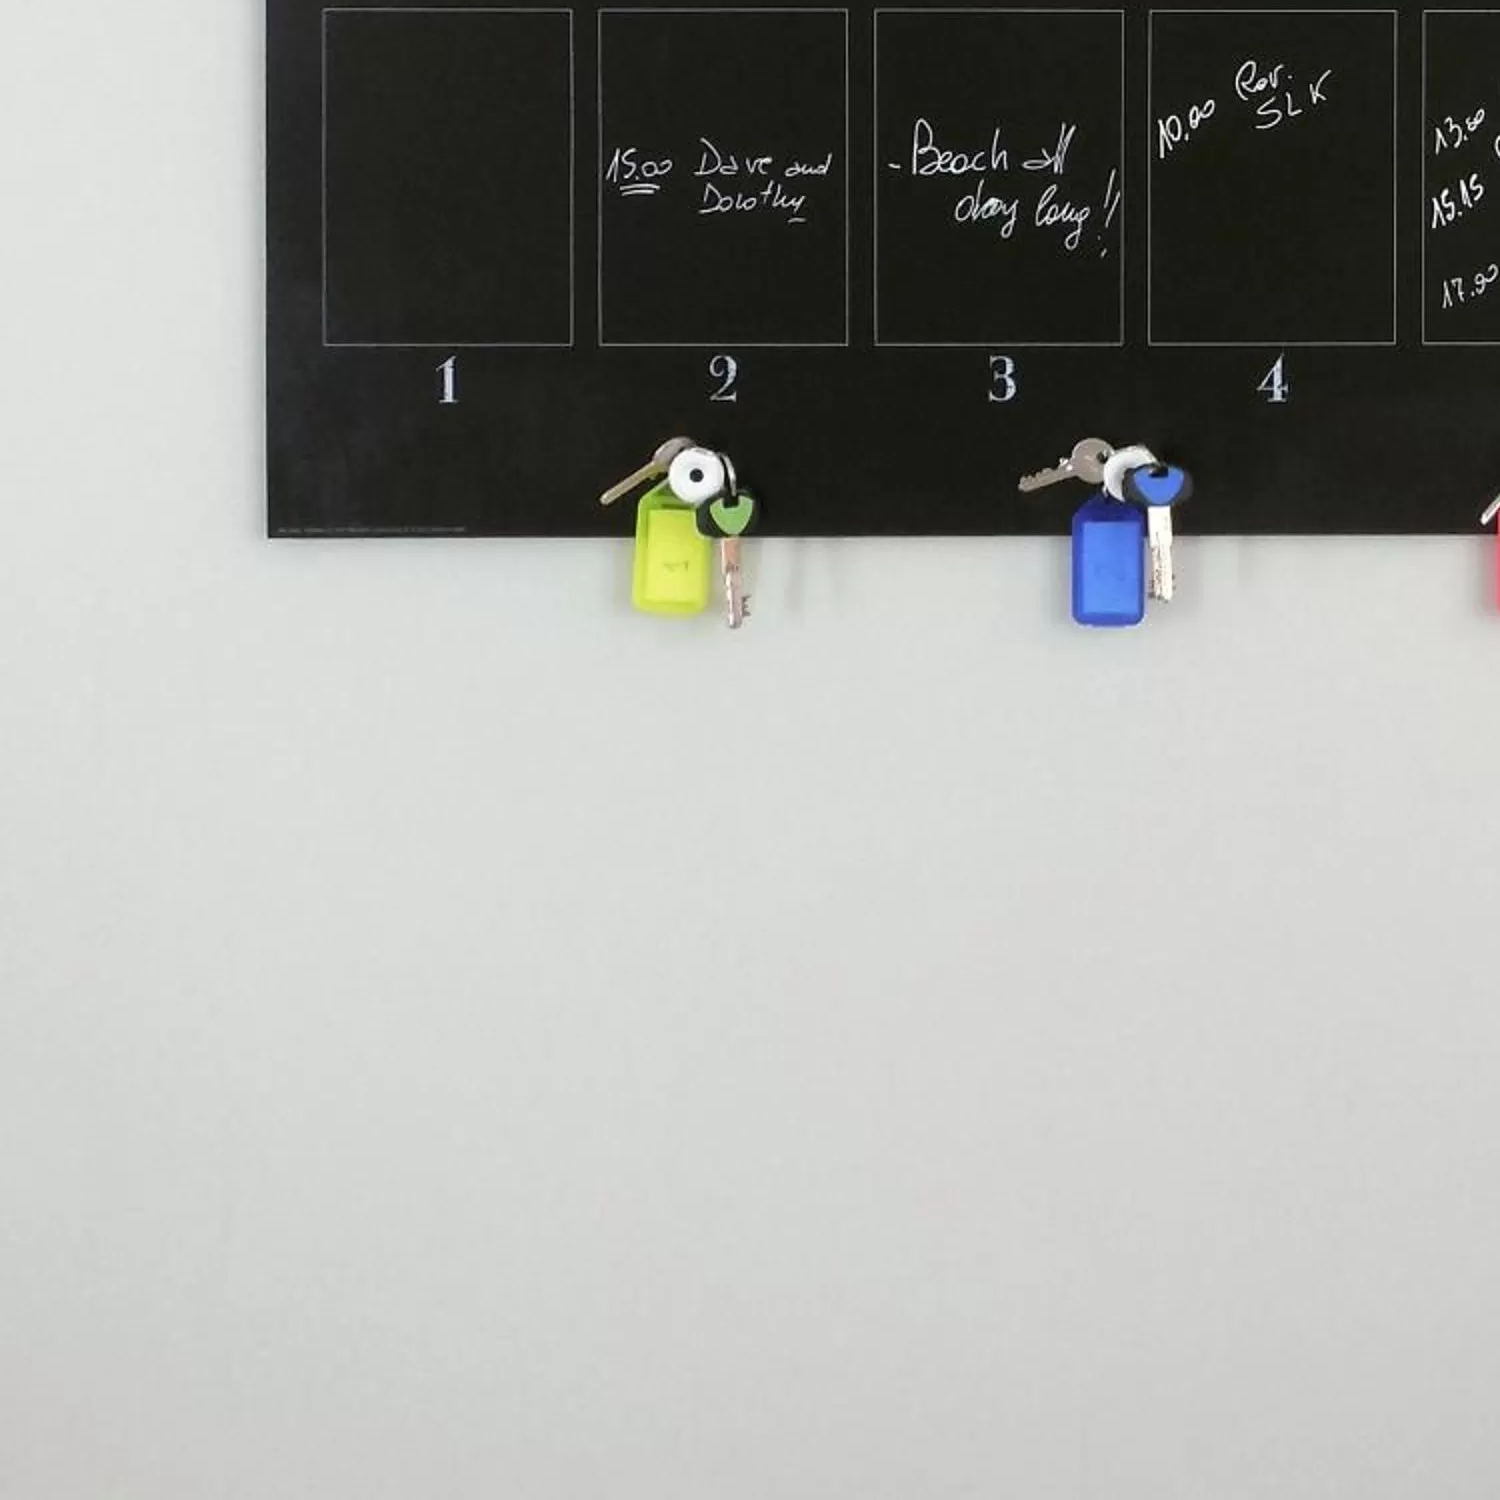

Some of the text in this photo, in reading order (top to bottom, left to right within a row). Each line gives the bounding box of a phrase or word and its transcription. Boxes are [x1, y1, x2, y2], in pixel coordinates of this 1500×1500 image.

[433, 355, 458, 405] 1
[708, 354, 738, 403] 2
[987, 354, 1018, 403] 3
[1256, 352, 1290, 403] 4
